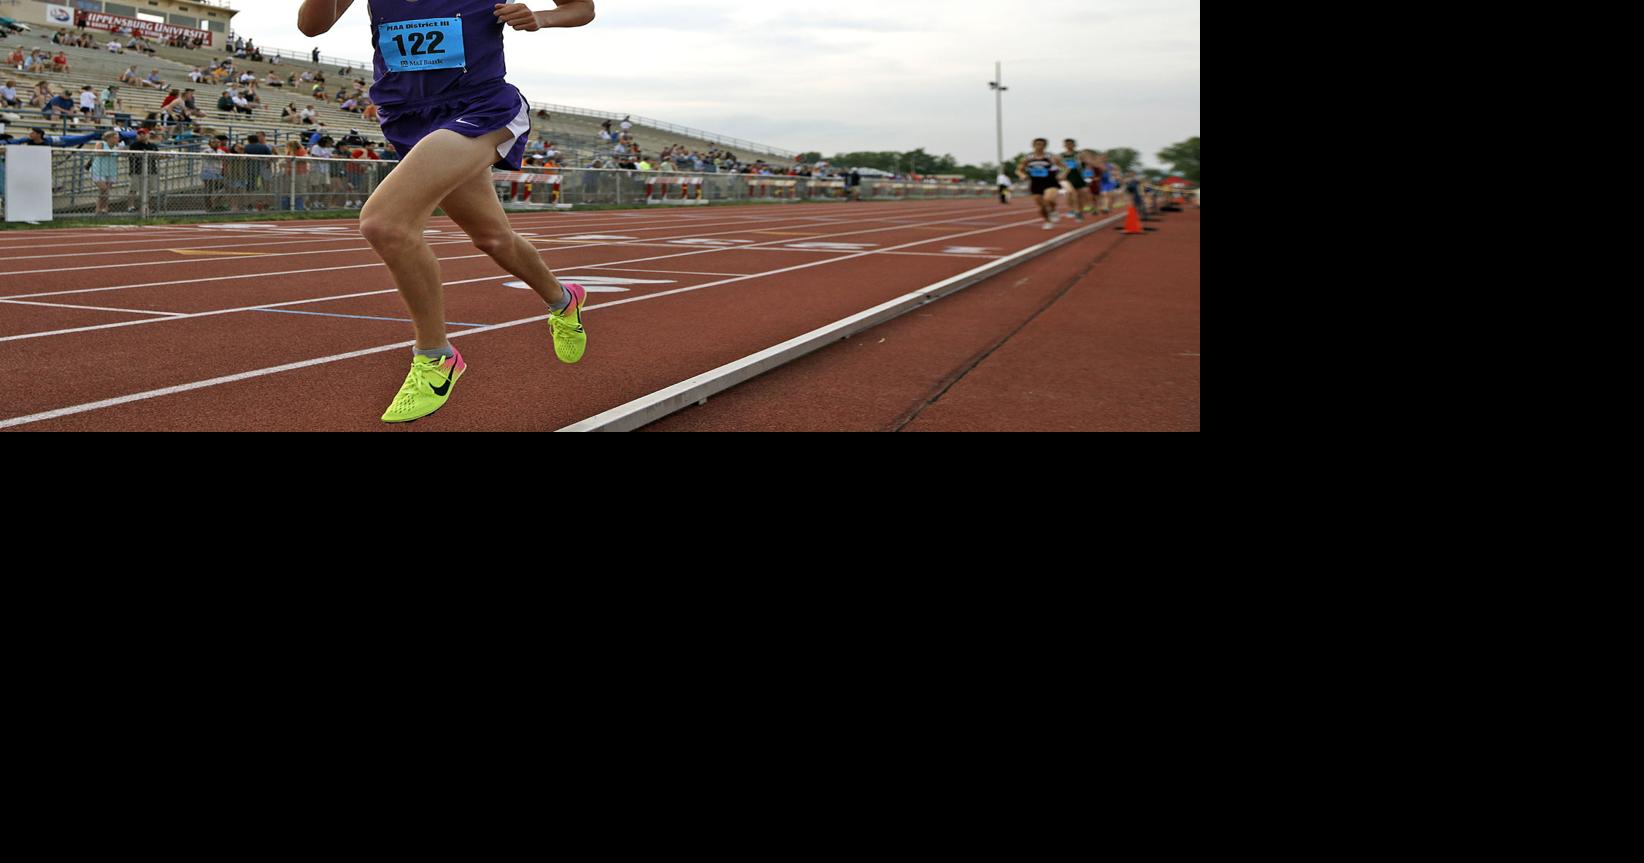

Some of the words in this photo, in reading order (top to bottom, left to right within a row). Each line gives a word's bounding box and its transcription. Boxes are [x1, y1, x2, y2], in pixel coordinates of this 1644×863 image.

[154, 22, 208, 39] UNIVERSITY
[406, 21, 438, 29] District
[392, 31, 446, 56] 122
